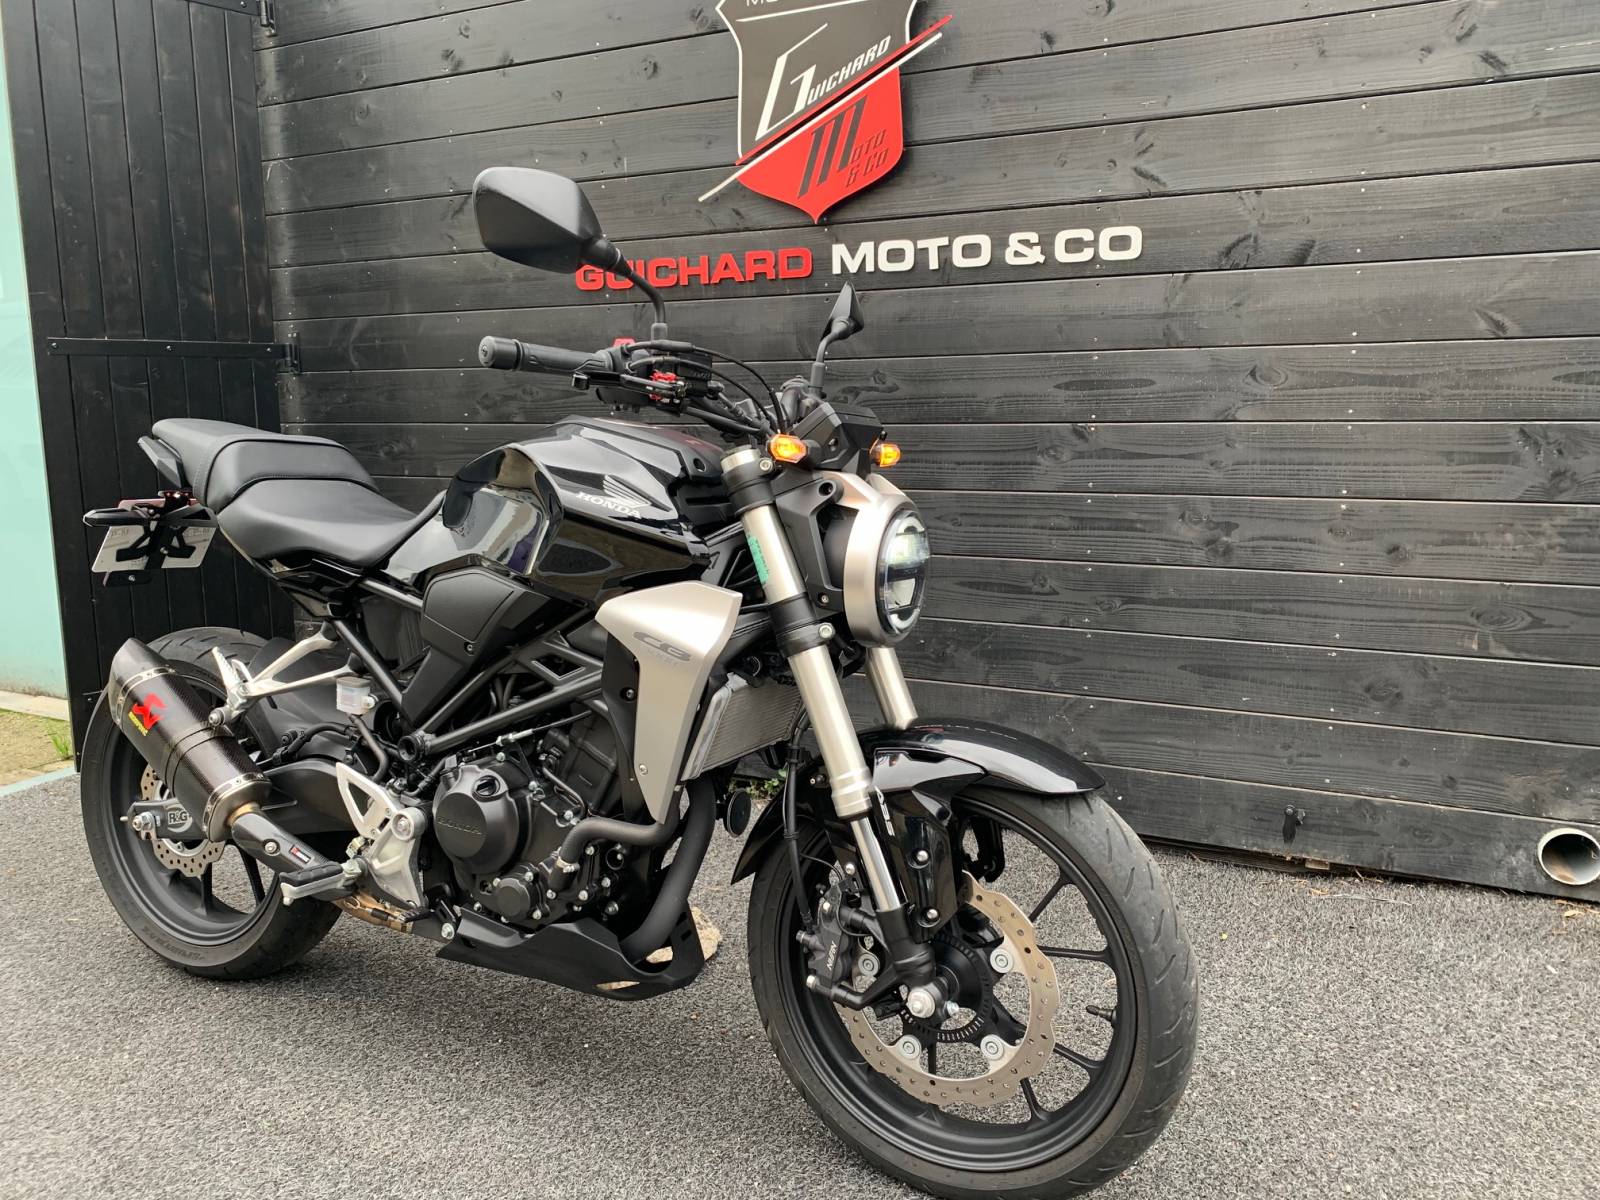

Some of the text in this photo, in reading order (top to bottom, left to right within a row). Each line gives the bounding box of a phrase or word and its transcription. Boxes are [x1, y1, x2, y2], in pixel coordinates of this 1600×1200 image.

[831, 233, 992, 275] MOTO
[1004, 231, 1046, 266] &
[1054, 225, 1143, 264] CO
[576, 491, 642, 519] HONDA
[167, 809, 189, 824] R&G
